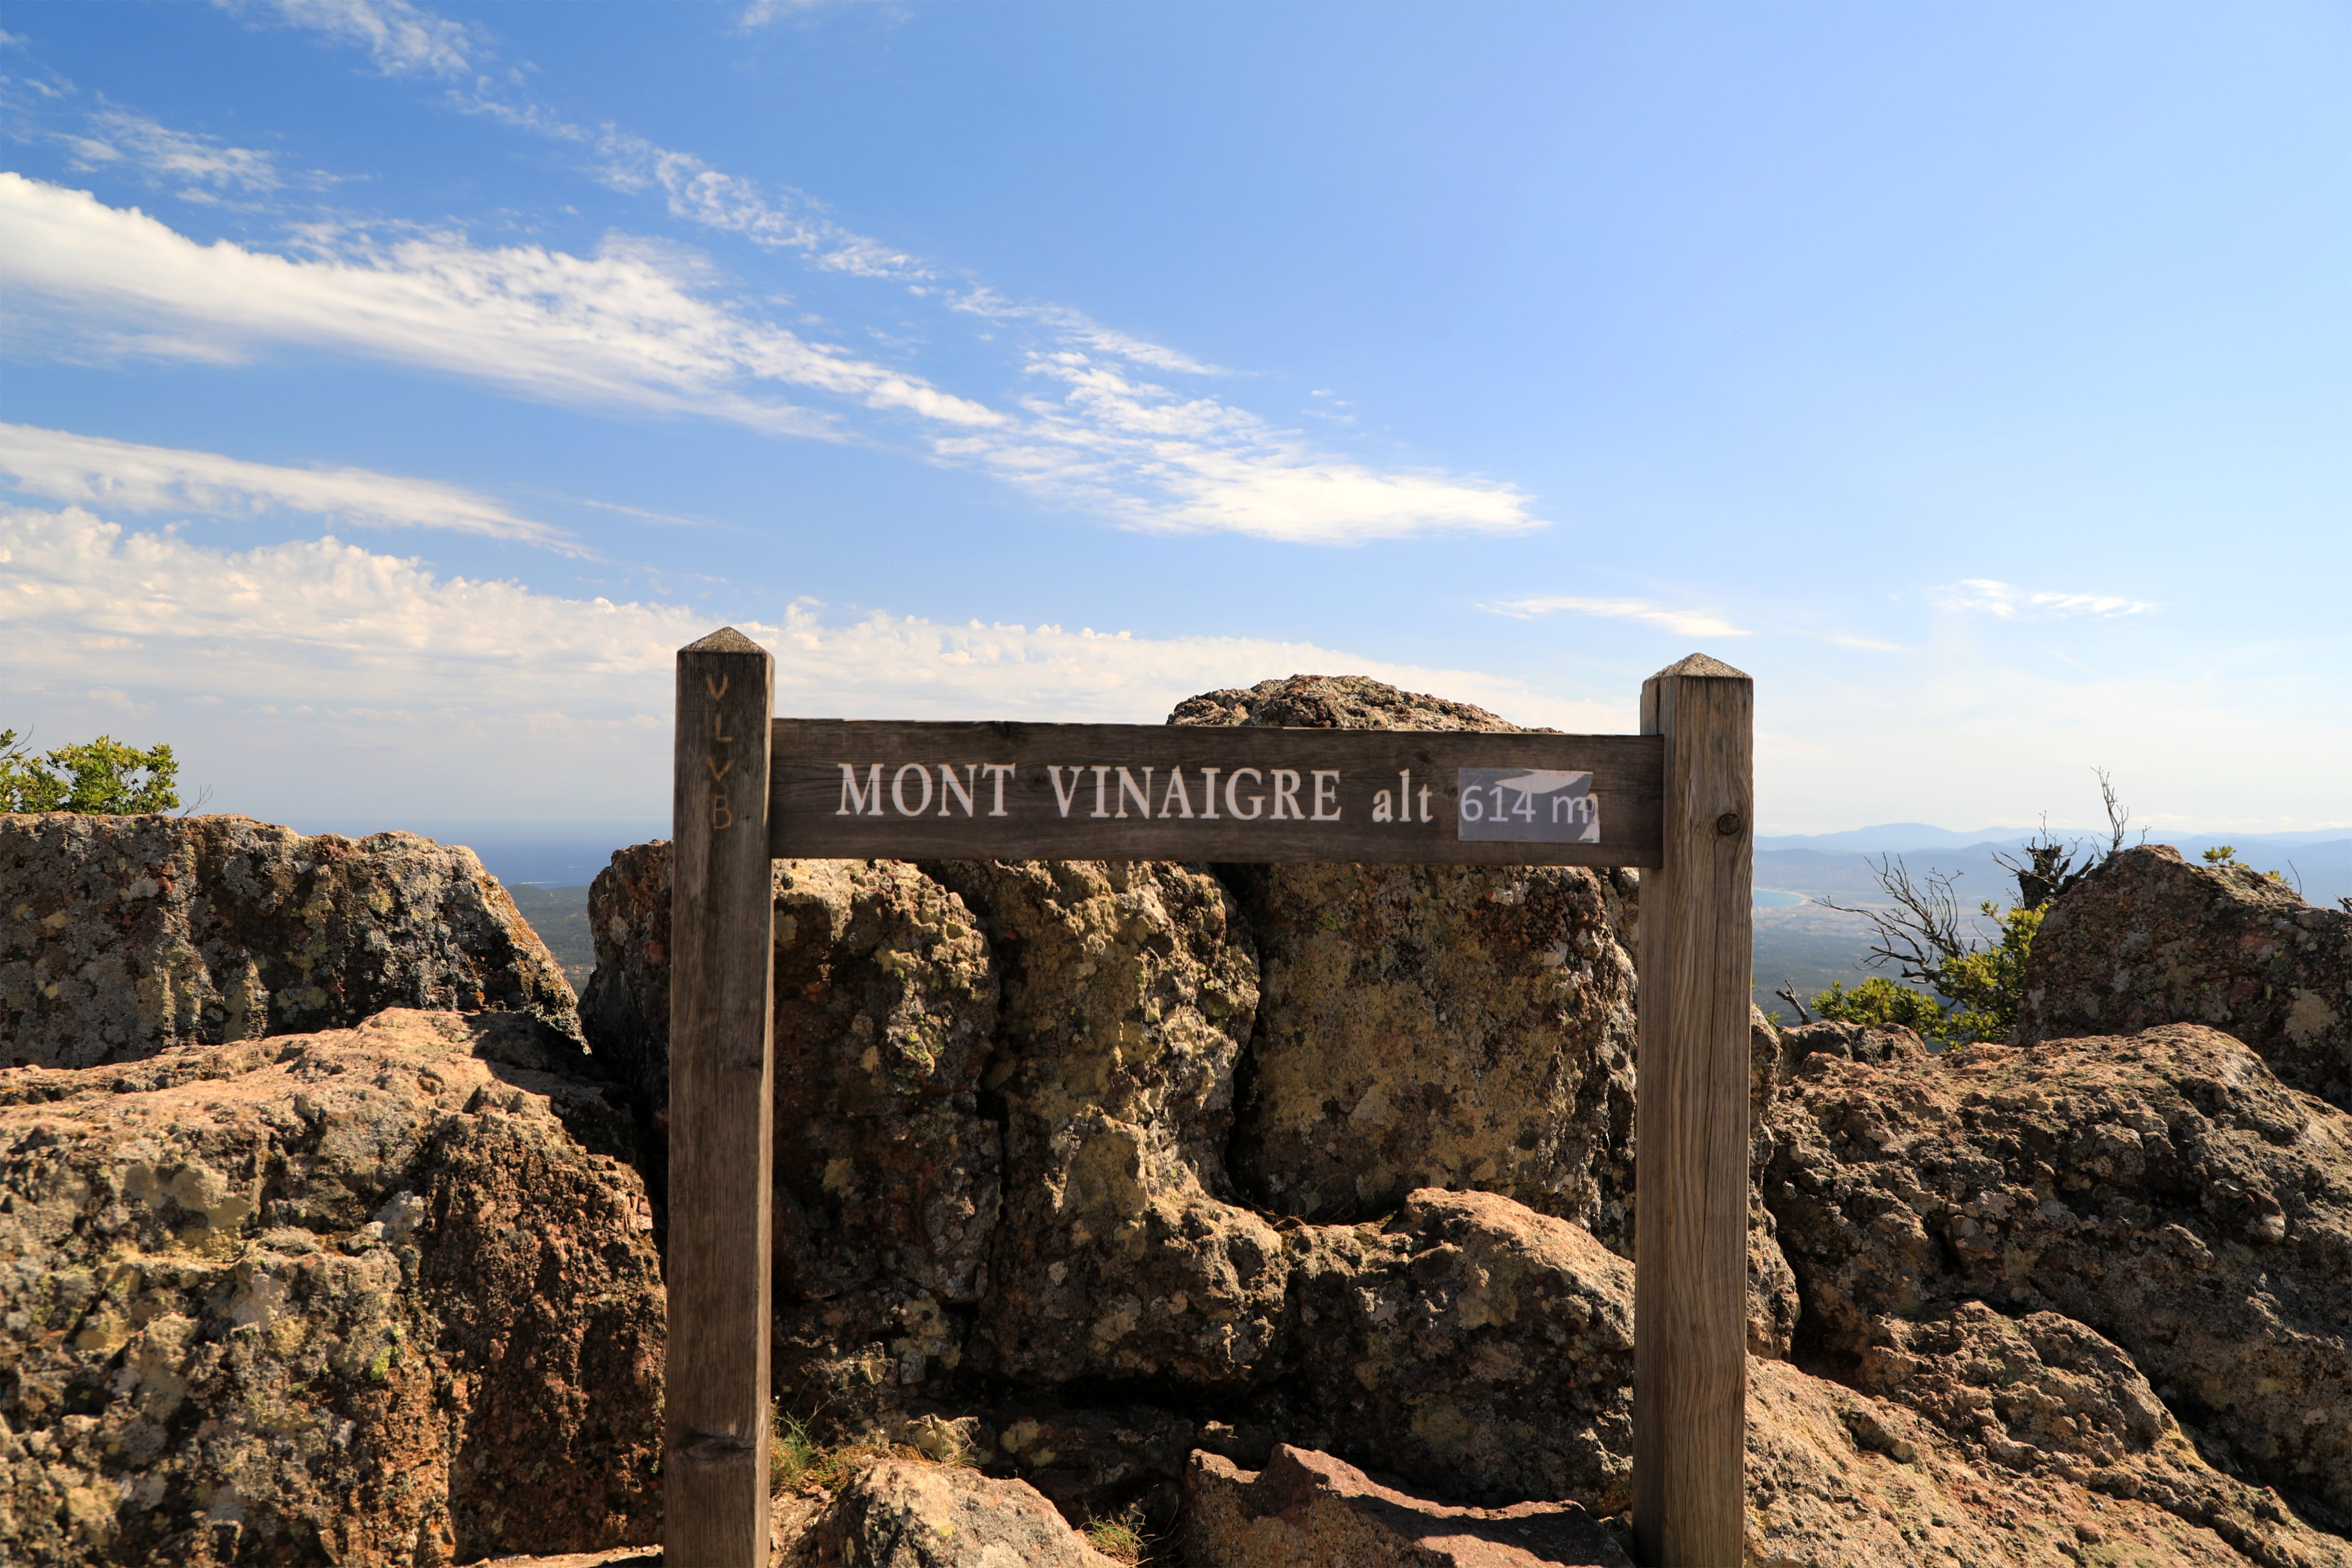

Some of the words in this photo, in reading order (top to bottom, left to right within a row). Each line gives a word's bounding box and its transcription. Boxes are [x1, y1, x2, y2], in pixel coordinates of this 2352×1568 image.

[836, 763, 1016, 817] MONT
[1047, 765, 1341, 821] VINAIGRE
[1371, 769, 1433, 823] alt
[1460, 785, 1536, 823] 614
[1553, 793, 1597, 824] m
